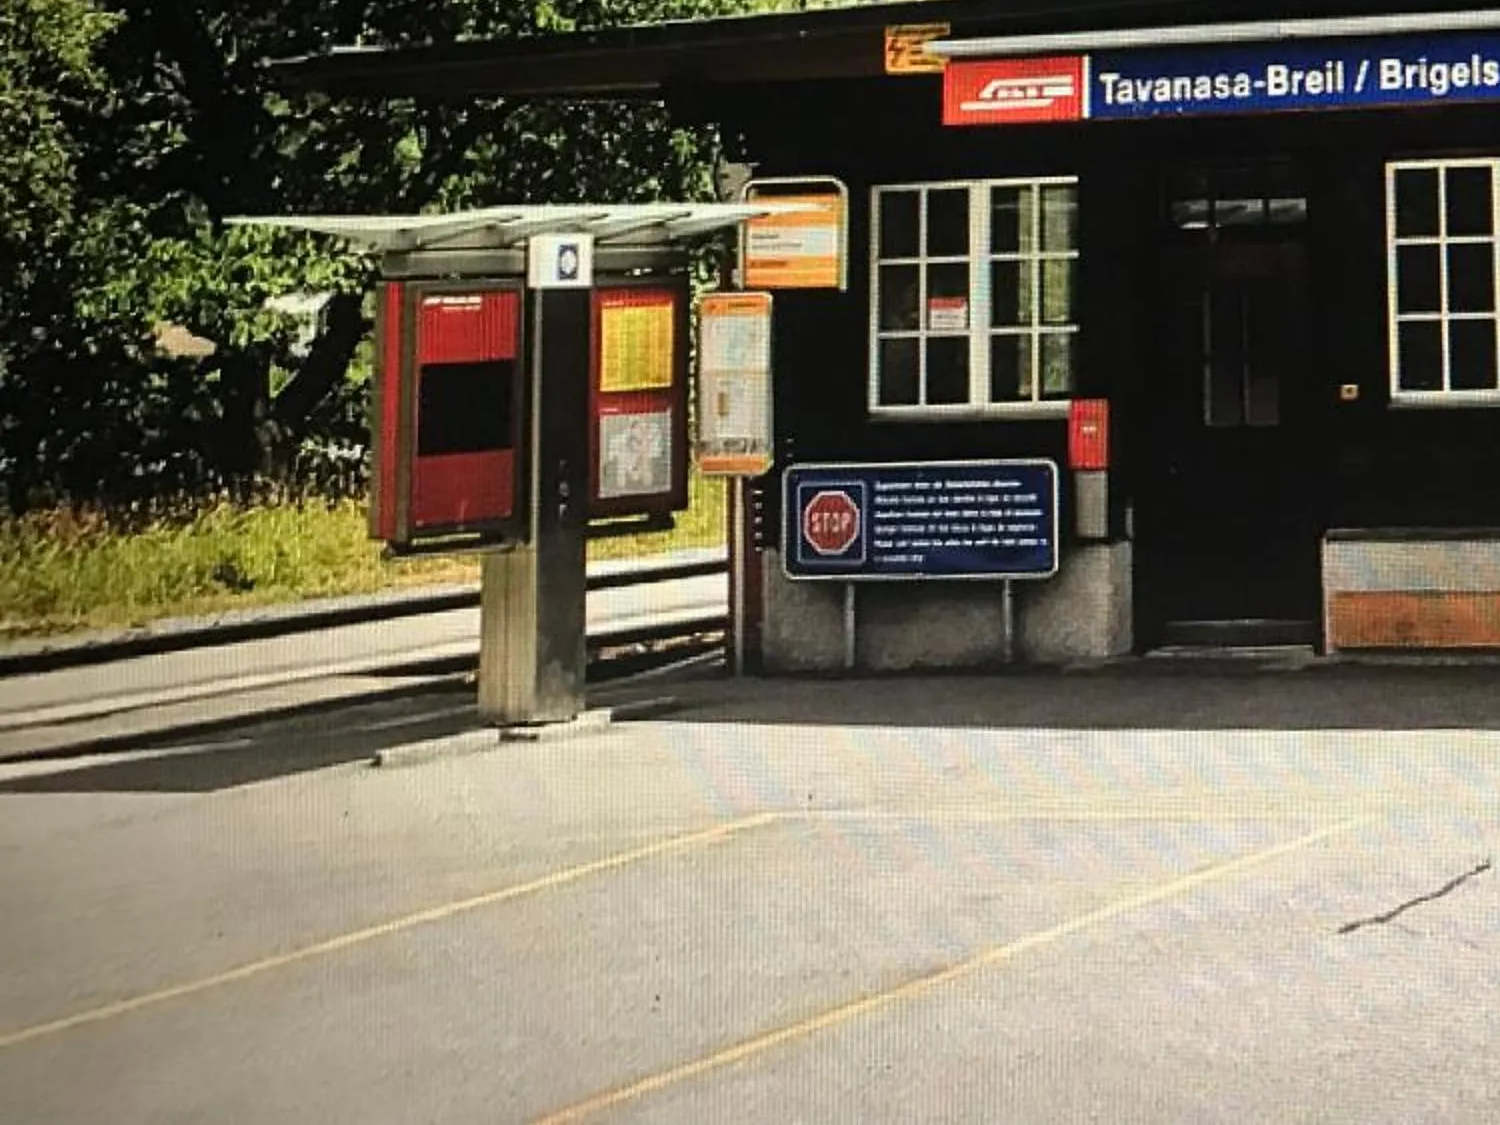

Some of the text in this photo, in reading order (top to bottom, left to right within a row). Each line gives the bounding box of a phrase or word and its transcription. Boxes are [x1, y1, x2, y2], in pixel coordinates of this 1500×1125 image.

[1099, 59, 1344, 105] Tavanasa-Breil
[1379, 53, 1500, 96] Brigels
[811, 512, 851, 533] STOP
